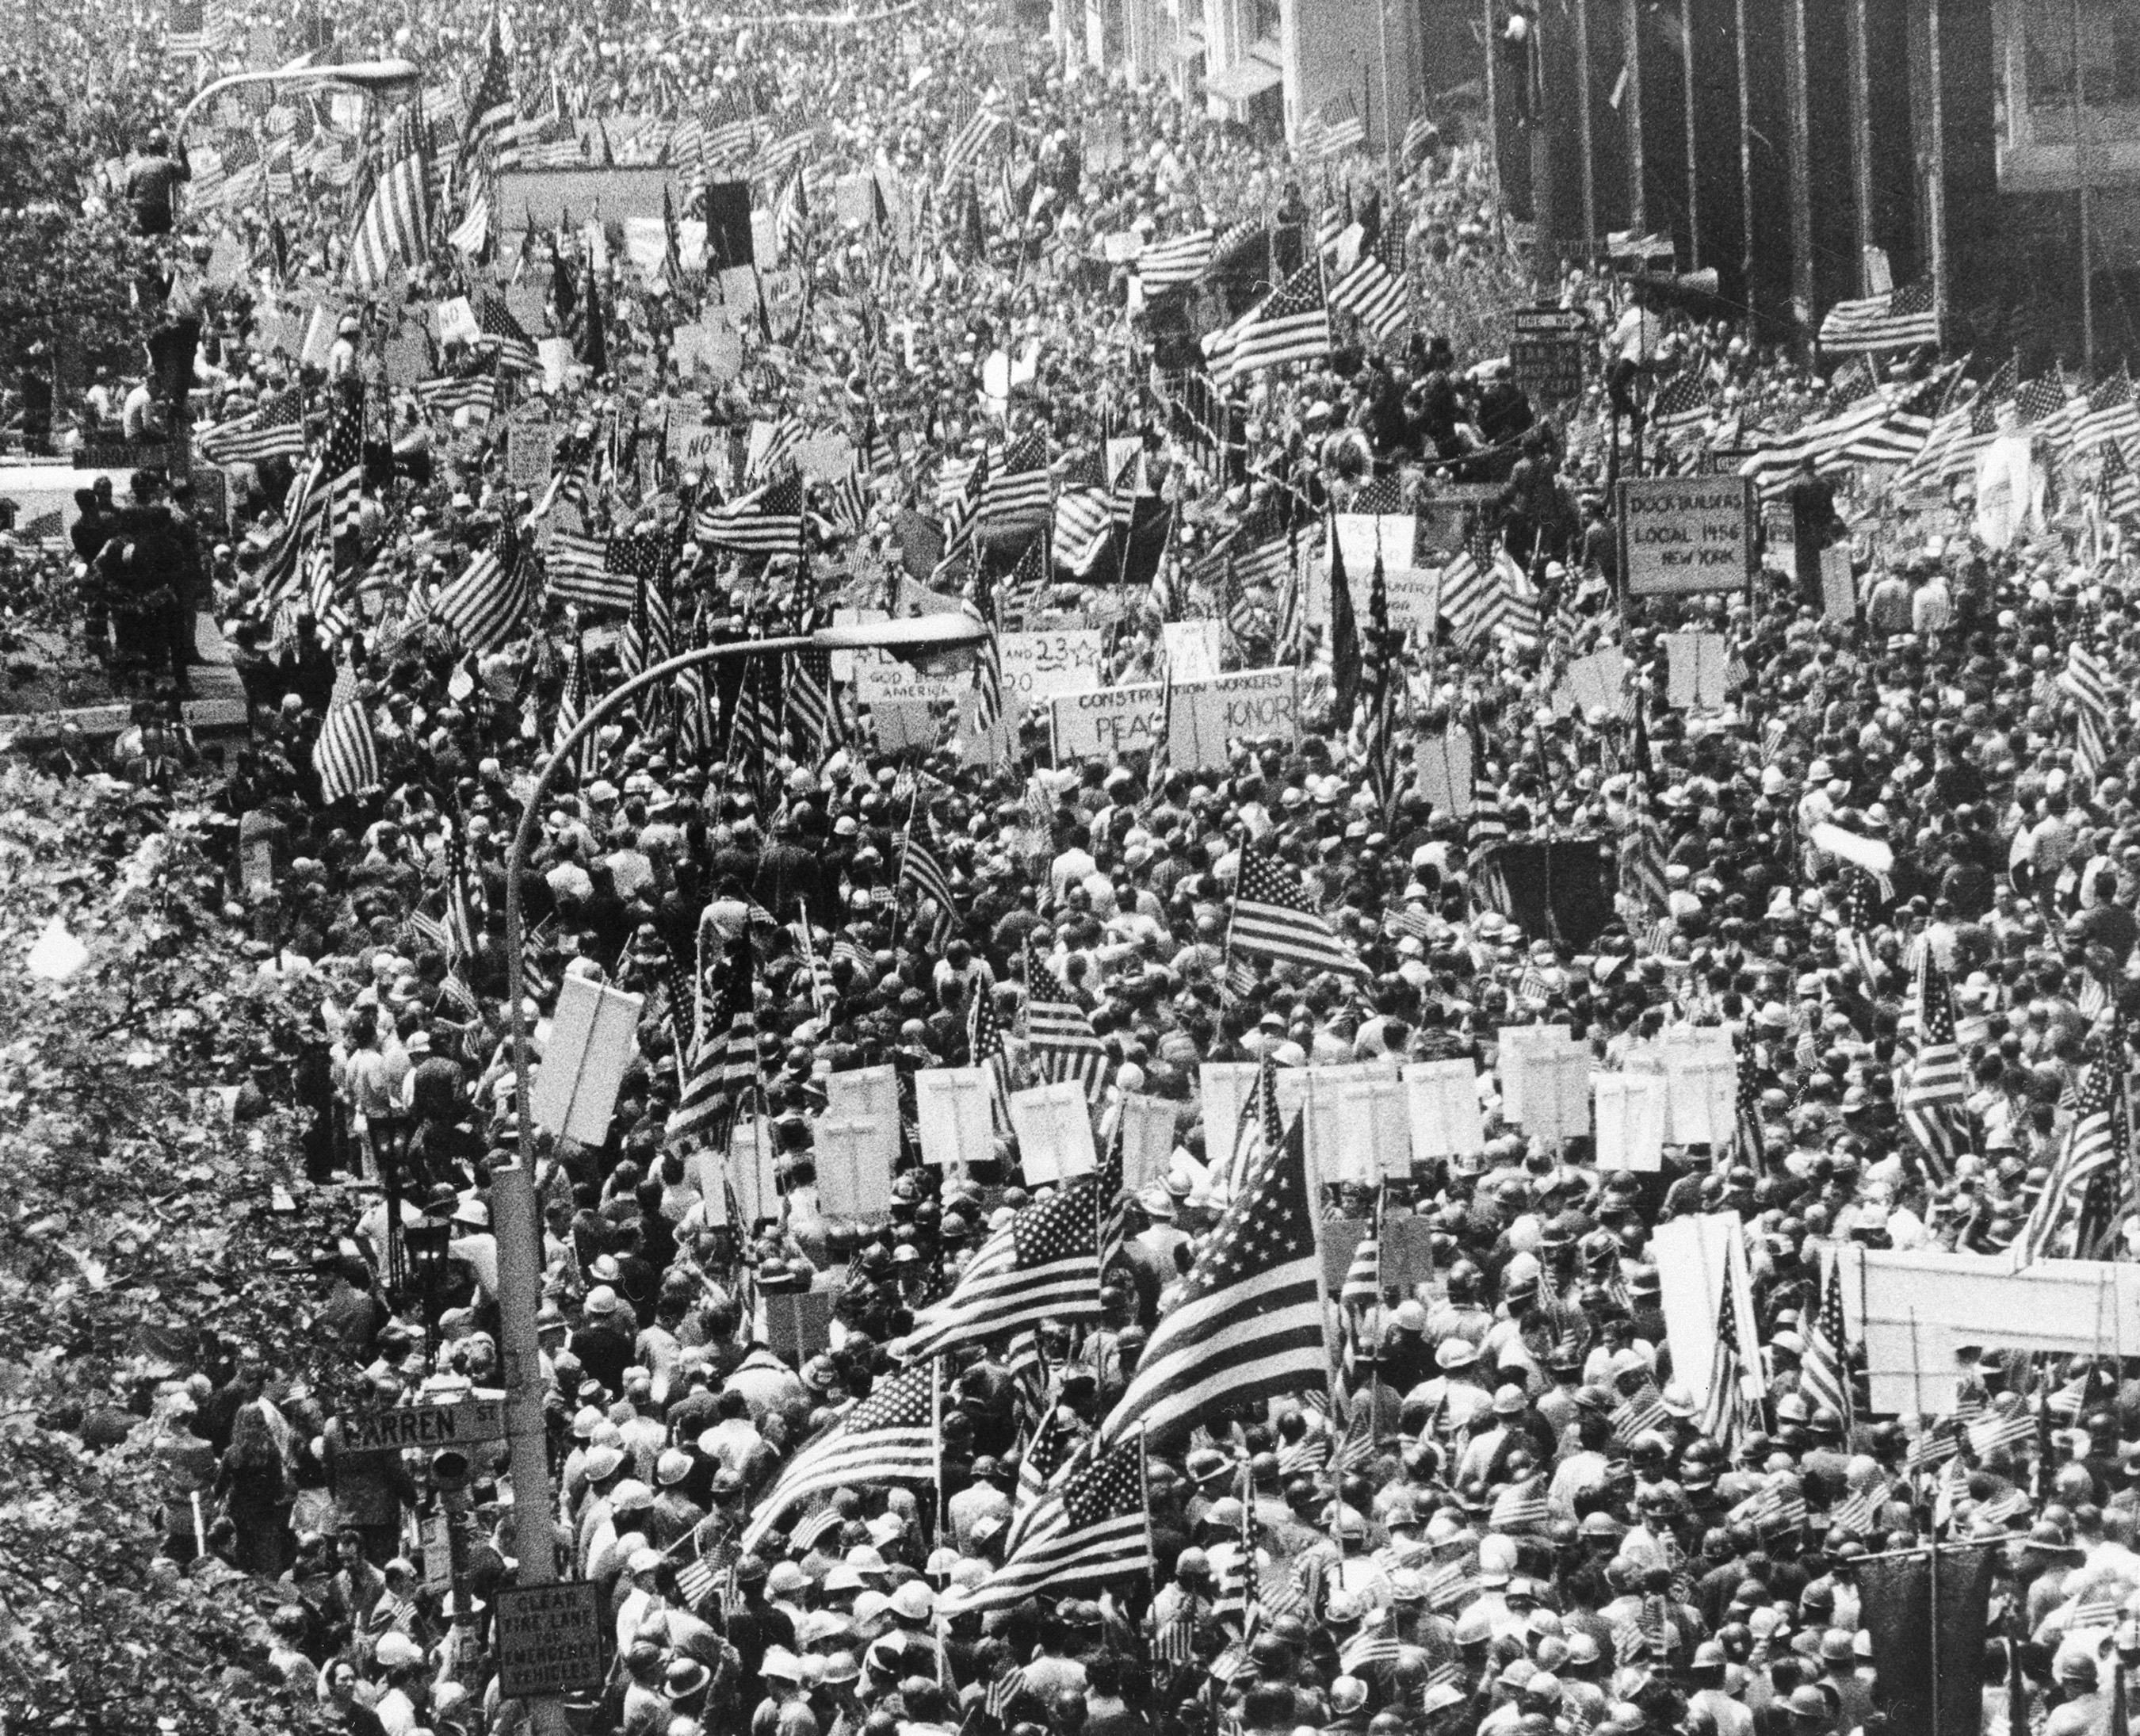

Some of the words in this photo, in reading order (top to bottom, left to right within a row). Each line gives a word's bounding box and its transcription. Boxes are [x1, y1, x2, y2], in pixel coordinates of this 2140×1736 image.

[687, 434, 713, 458] NO
[1634, 526, 1692, 544] LOCAL
[1661, 549, 1694, 565] NEW
[1698, 548, 1736, 566] YORK
[1006, 648, 1033, 660] AND
[1036, 637, 1068, 663] 23
[869, 673, 902, 685] GOD
[1216, 674, 1282, 691] WORKERS
[476, 1405, 496, 1421] ST
[517, 1592, 577, 1613] CLEAR
[504, 1613, 542, 1633] FIRE
[550, 1609, 591, 1629] LANE
[504, 1642, 598, 1666] EMERGENCY
[512, 1661, 592, 1685] VEHICLES
